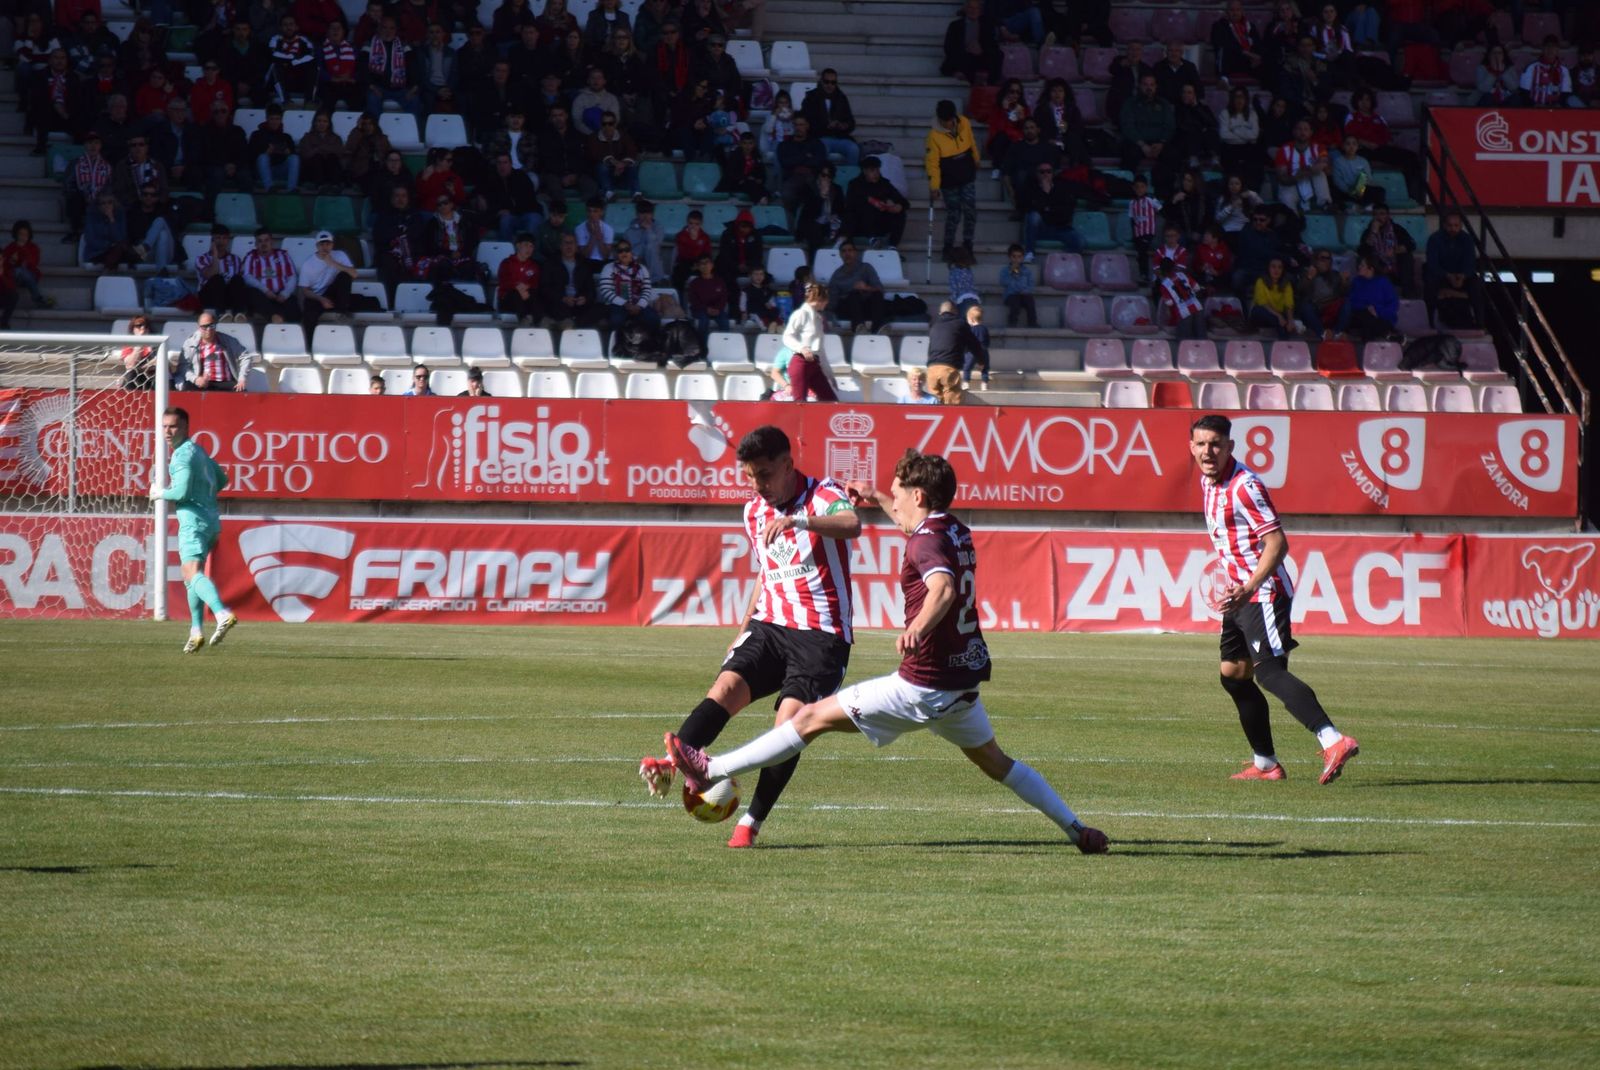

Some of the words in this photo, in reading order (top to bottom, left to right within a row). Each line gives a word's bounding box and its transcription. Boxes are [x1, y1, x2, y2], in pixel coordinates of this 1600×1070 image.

[44, 427, 220, 463] CENTO
[232, 421, 389, 463] ÓPTICO
[464, 405, 590, 464] fisio
[905, 414, 1163, 476] ZAMORA
[1246, 425, 1274, 474] 8
[1381, 427, 1410, 476] 8
[1520, 429, 1550, 478] 8
[124, 462, 313, 493] RERTO
[464, 484, 566, 493] POLICLÍNICA
[465, 451, 609, 493] readapt
[627, 459, 753, 497] podoact
[710, 489, 717, 498] Y
[955, 484, 1064, 502] TAMIENTO
[1340, 450, 1391, 509] ZAMORA
[1481, 451, 1529, 511] ZAMORA
[350, 549, 611, 599] FRIMAY
[1353, 551, 1449, 625] CF
[980, 600, 1040, 629] S.L.
